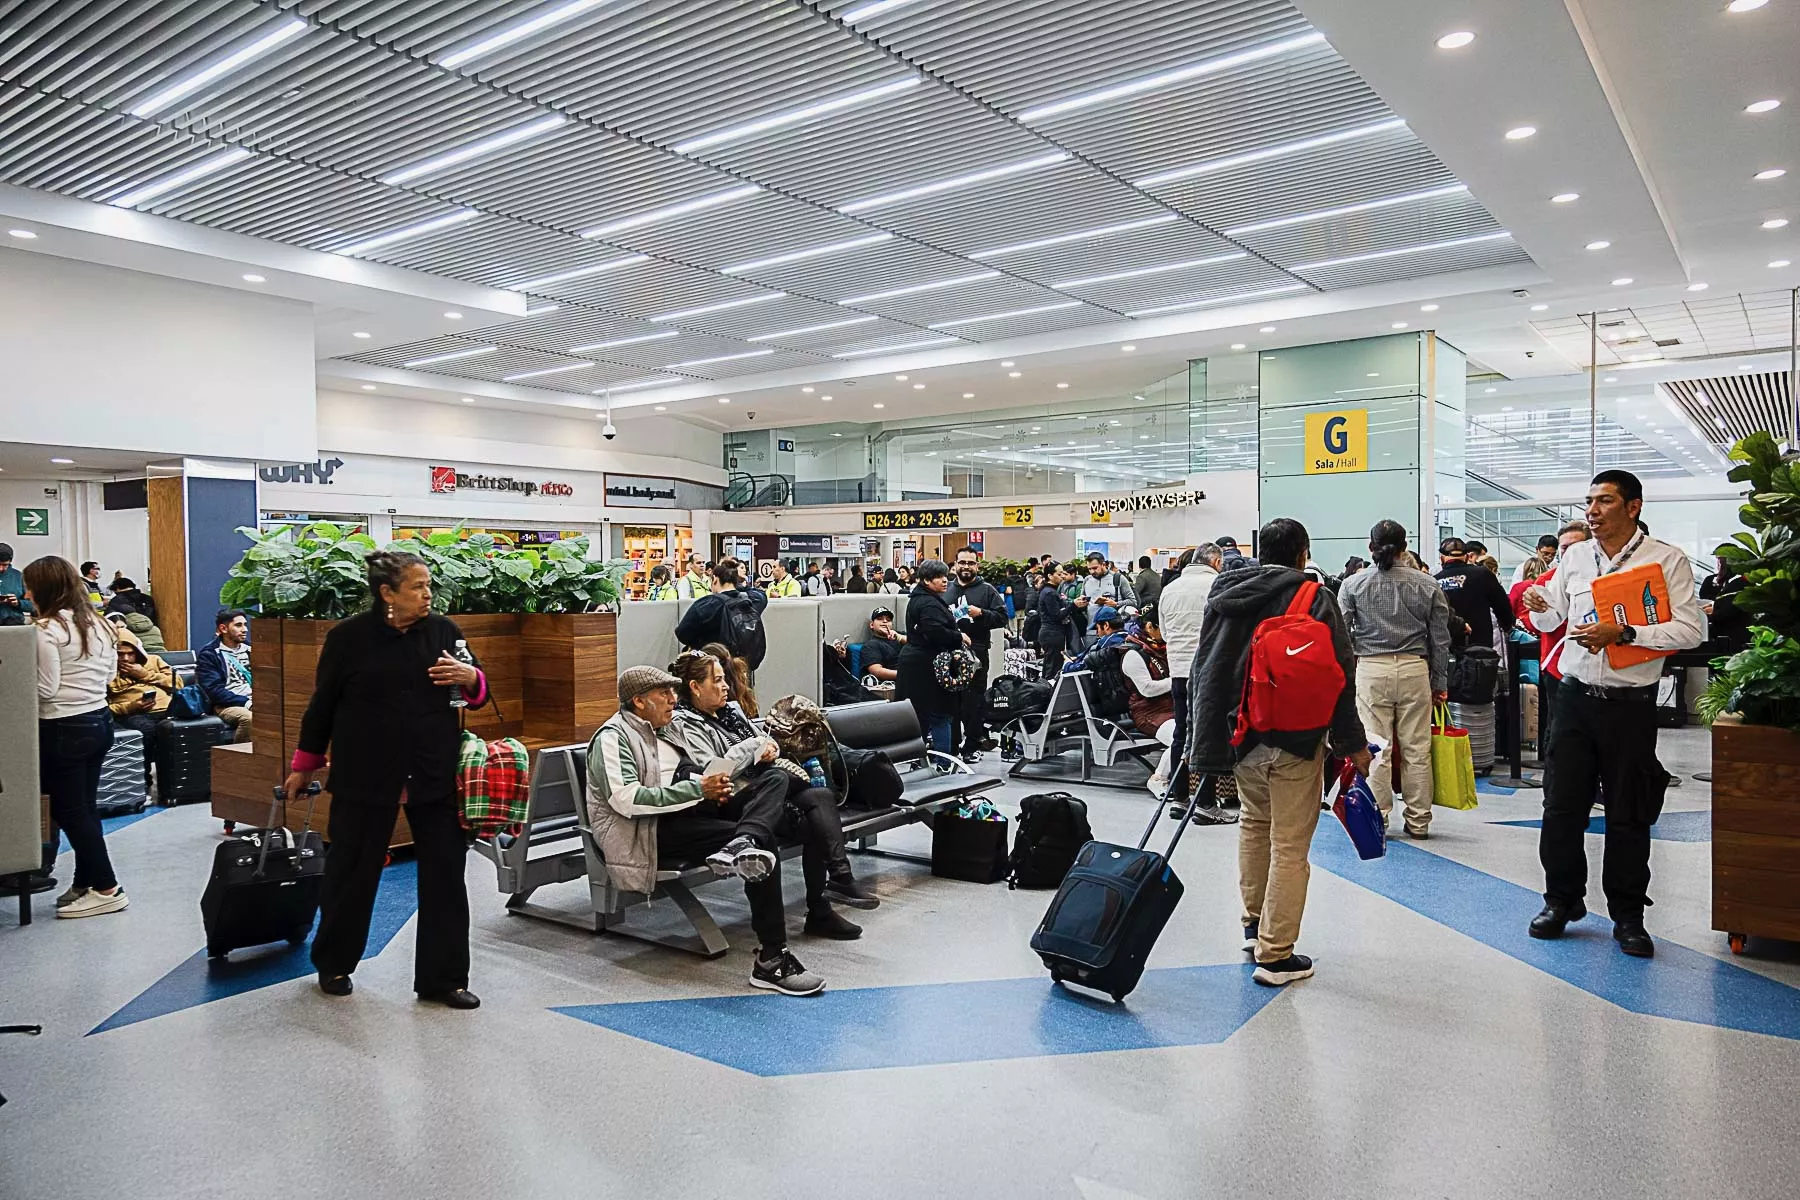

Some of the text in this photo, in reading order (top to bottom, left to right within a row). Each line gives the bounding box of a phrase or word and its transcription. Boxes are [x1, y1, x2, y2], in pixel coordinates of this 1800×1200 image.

[1323, 416, 1348, 454] G
[1315, 458, 1334, 469] Sala
[1341, 457, 1357, 468] Hall
[1089, 497, 1136, 514] MAISON
[877, 512, 952, 527] 26-28 29-36
[1016, 508, 1031, 523] 25
